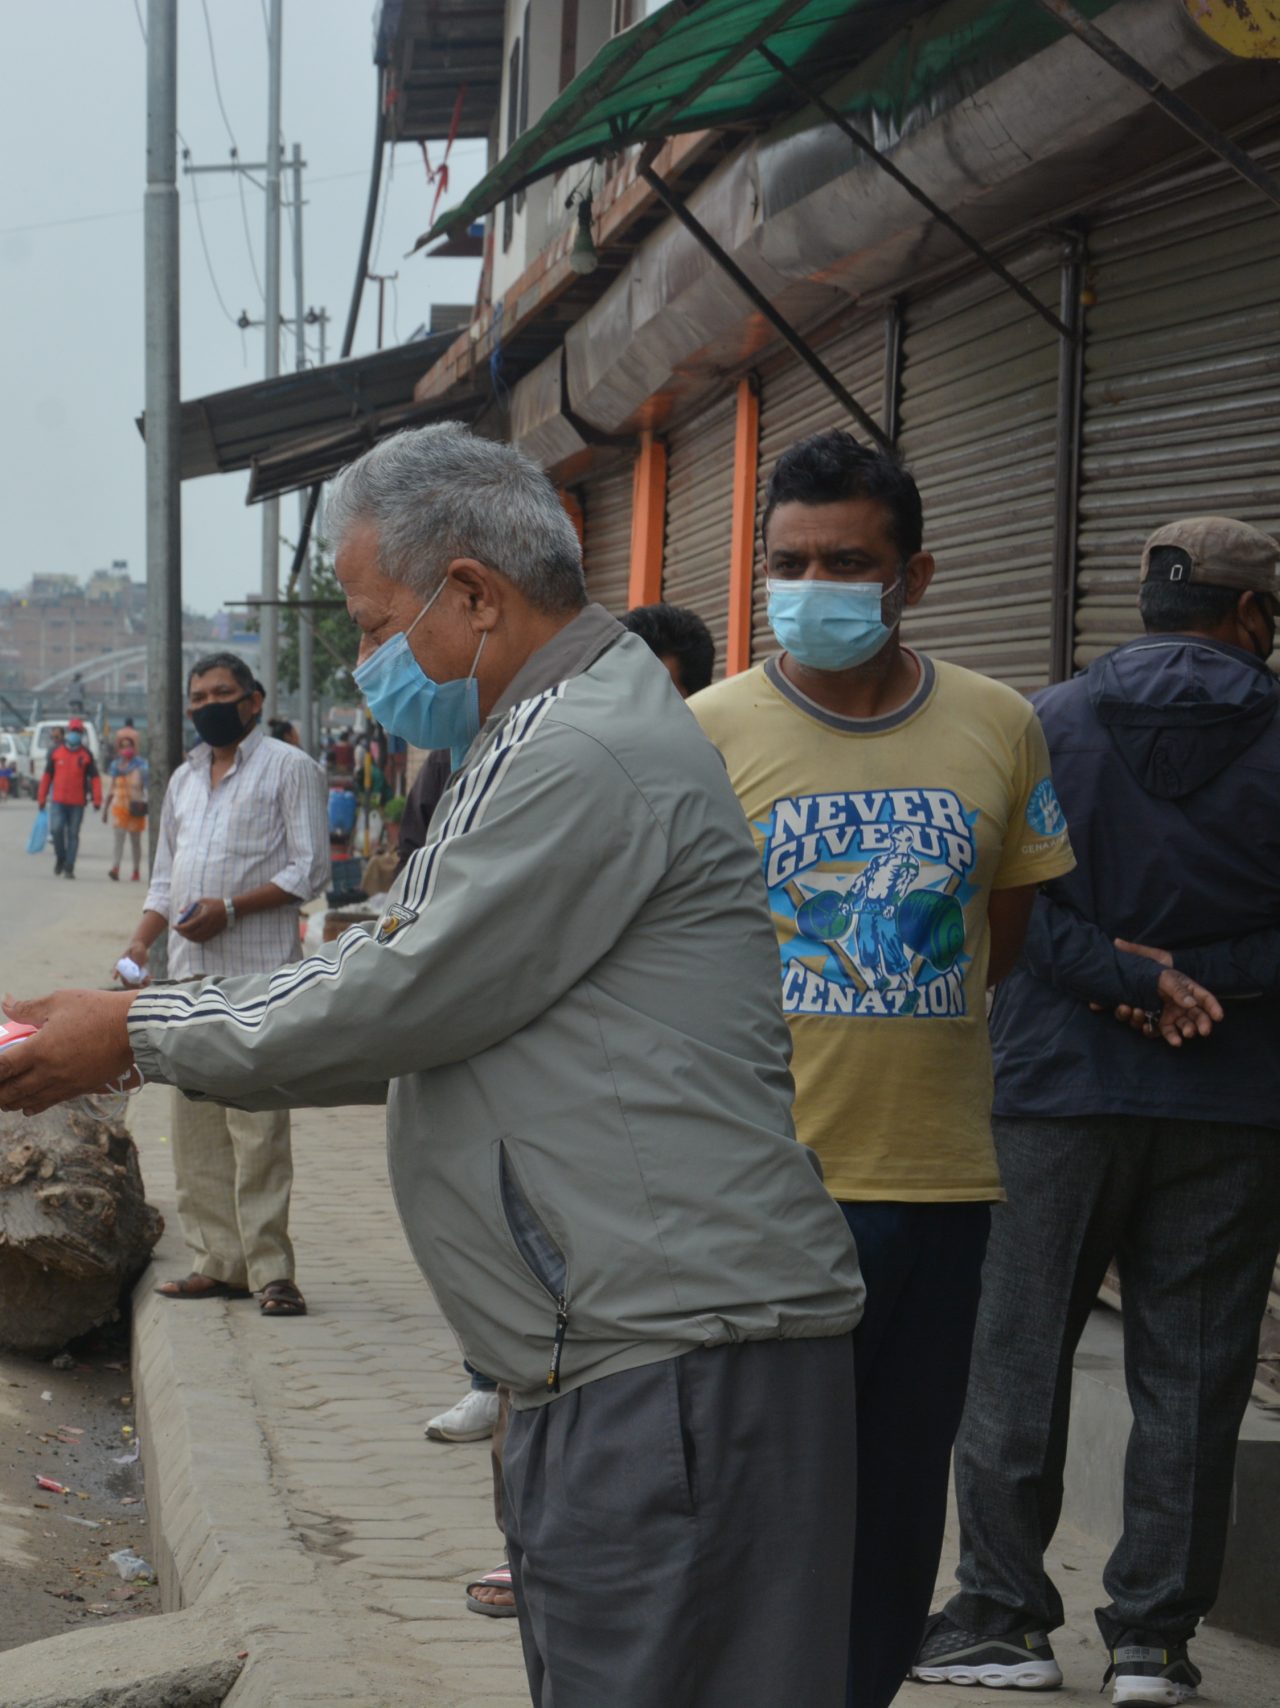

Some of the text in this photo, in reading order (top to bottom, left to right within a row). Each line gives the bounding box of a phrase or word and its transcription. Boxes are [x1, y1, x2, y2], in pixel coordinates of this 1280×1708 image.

[772, 790, 970, 846] NEVER
[767, 823, 972, 887] GIVE UP
[782, 958, 964, 1015] CENATION
